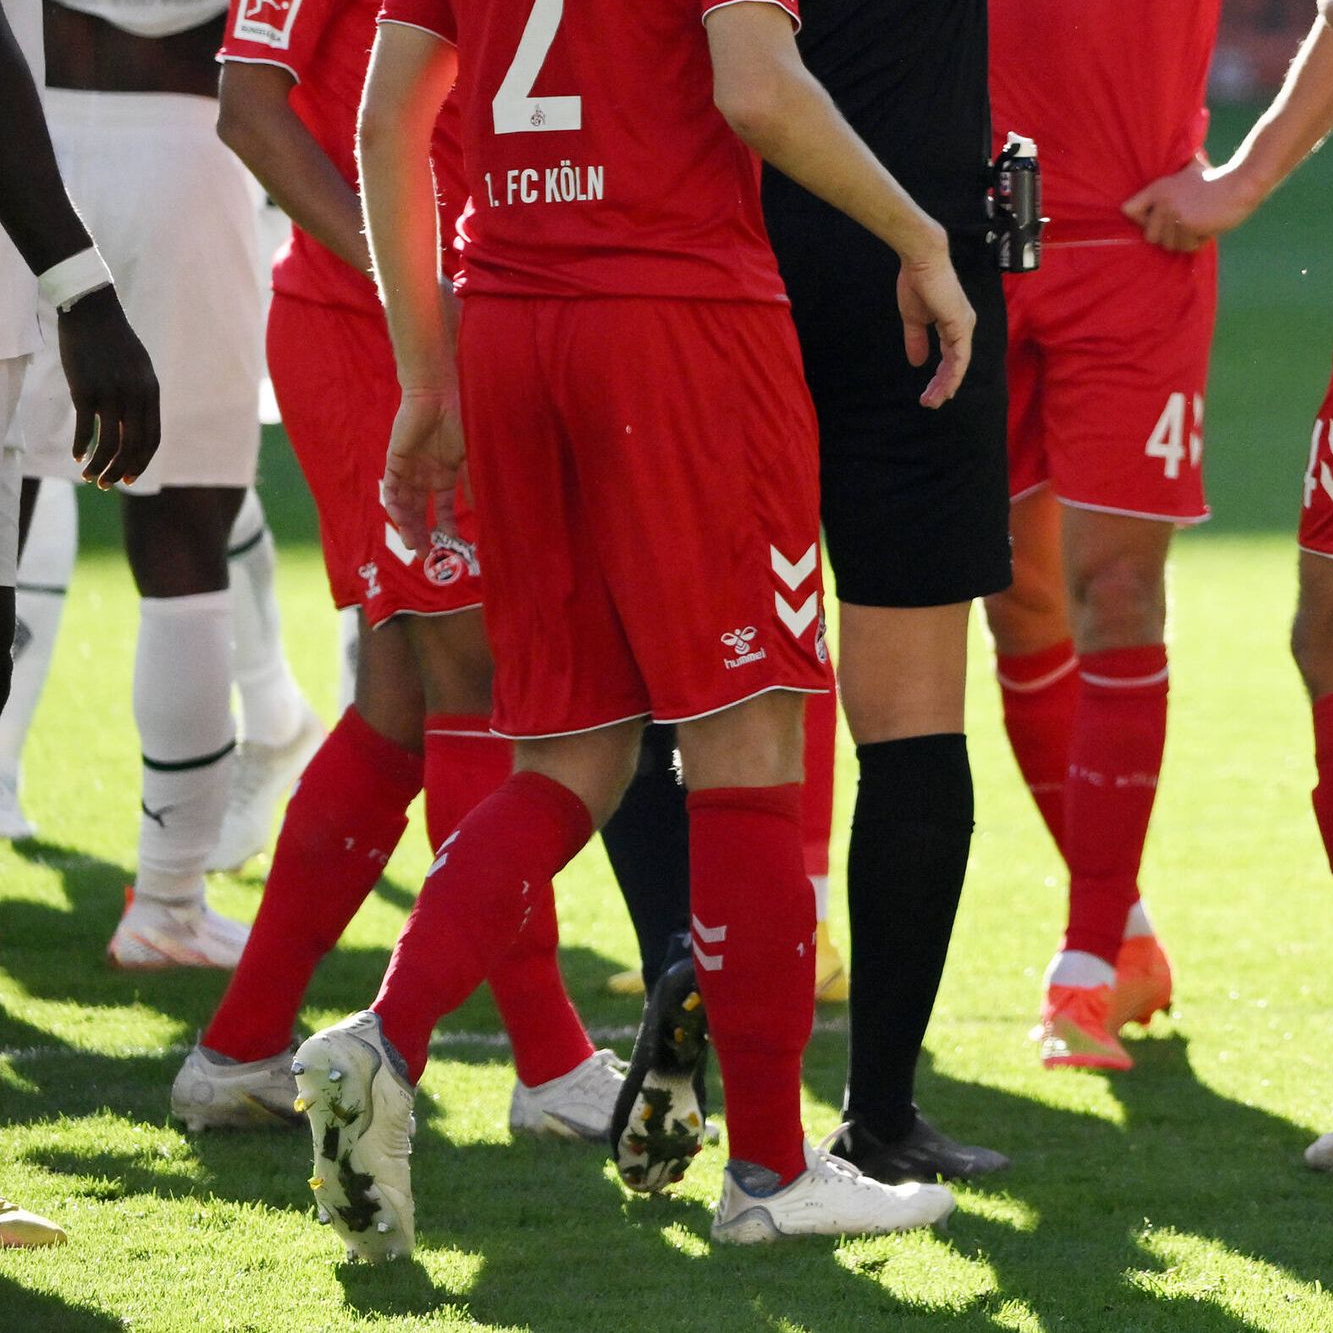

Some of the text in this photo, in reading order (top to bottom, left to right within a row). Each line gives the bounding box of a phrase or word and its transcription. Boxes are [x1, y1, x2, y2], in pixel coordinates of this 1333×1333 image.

[485, 158, 605, 207] 1. FC KÖLN
[723, 647, 767, 670] hummel
